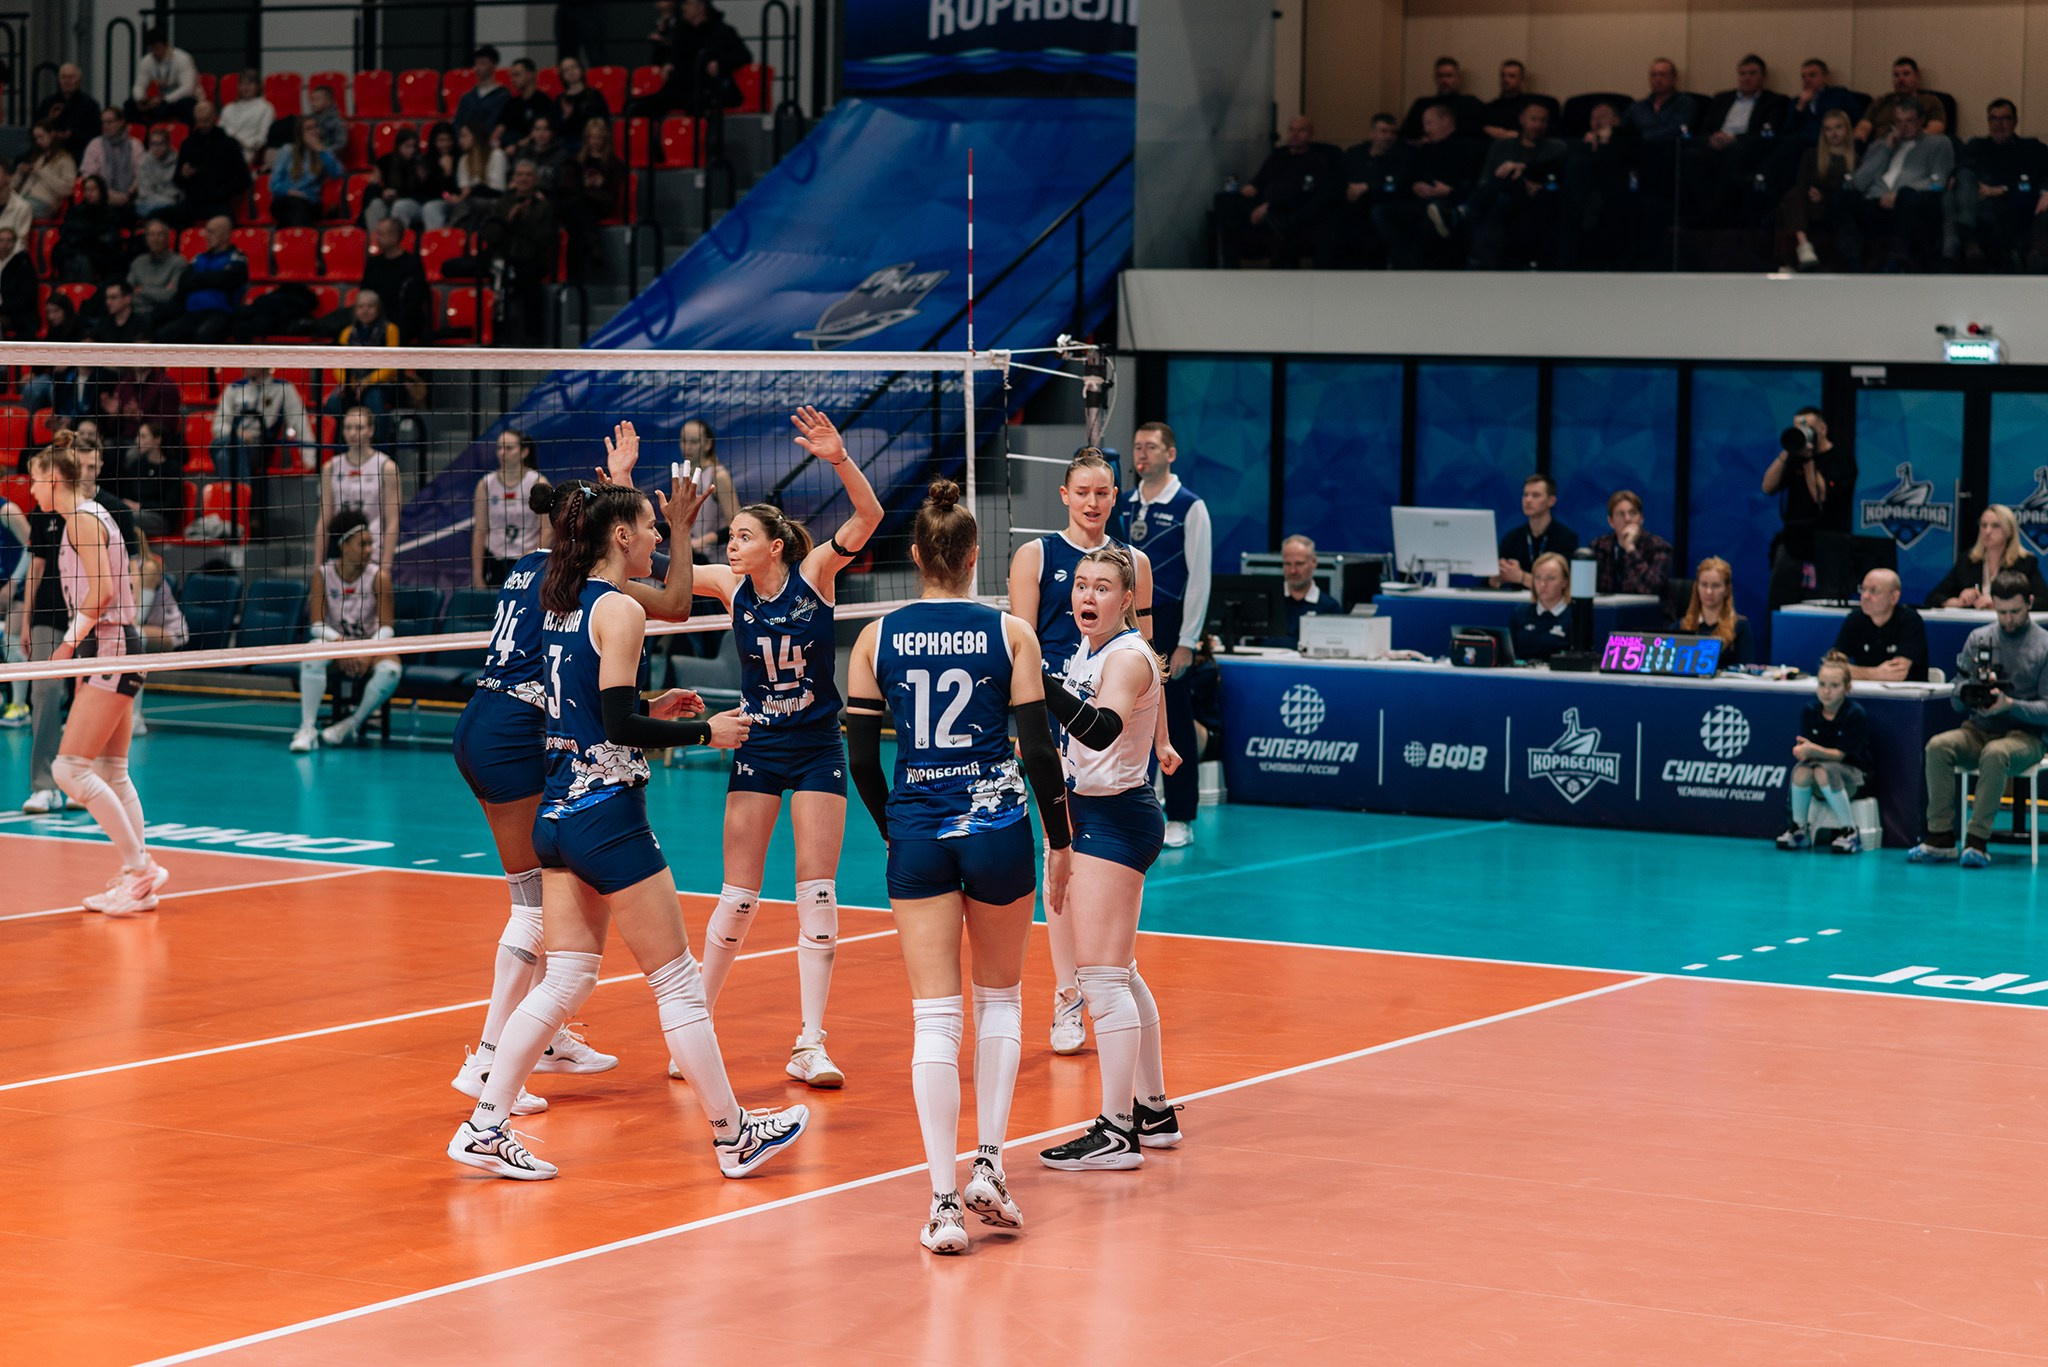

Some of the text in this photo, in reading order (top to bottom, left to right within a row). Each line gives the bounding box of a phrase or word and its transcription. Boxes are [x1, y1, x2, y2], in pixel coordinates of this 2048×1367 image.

[1866, 505, 1948, 524] КОРАБЕЛКА
[892, 631, 988, 656] ЧЕРНЯЕВА
[757, 634, 807, 682] 14
[1609, 645, 1641, 671] 15
[1682, 649, 1713, 674] 15
[906, 668, 973, 749] 12
[1245, 737, 1359, 762] СУПЕРЛИГА
[1427, 743, 1488, 771] ВФВ
[906, 761, 981, 784] КОРАБЕЛКА
[1259, 761, 1340, 776] ЧЕМПИОНАТ РОССИИ
[1533, 753, 1615, 777] КОРАБЕЛКА
[1661, 760, 1787, 788] СУПЕРЛИГА
[1676, 785, 1766, 802] ЧЕМПИОНАТ РОССИИ
